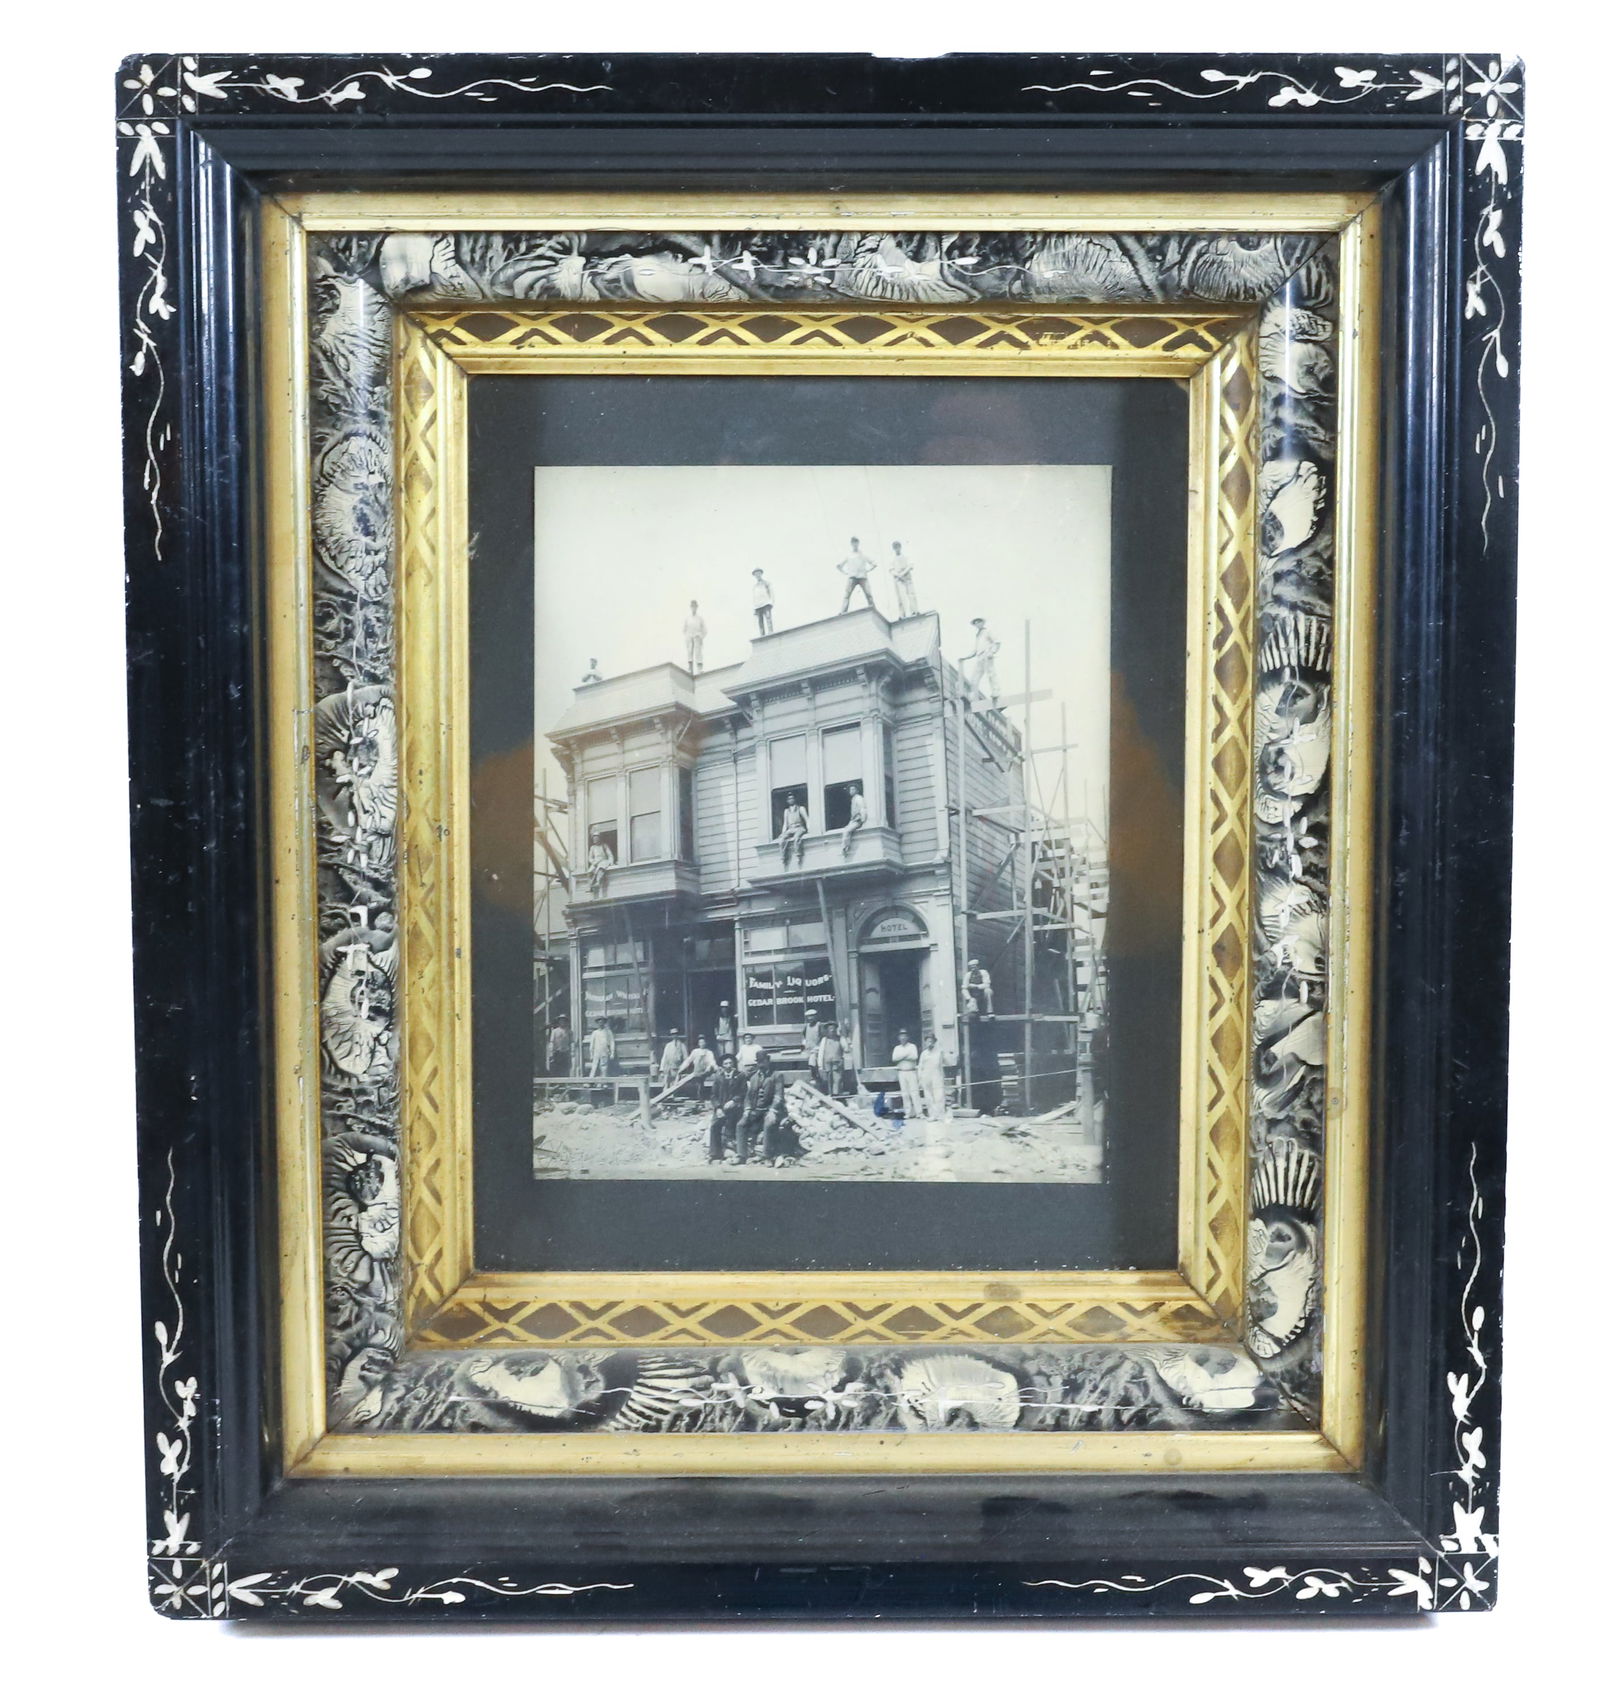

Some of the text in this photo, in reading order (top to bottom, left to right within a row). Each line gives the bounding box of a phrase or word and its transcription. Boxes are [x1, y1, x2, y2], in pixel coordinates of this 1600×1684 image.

[881, 923, 908, 932] HOTEL
[748, 998, 774, 1007] CEDAR
[776, 996, 804, 1005] BROOK
